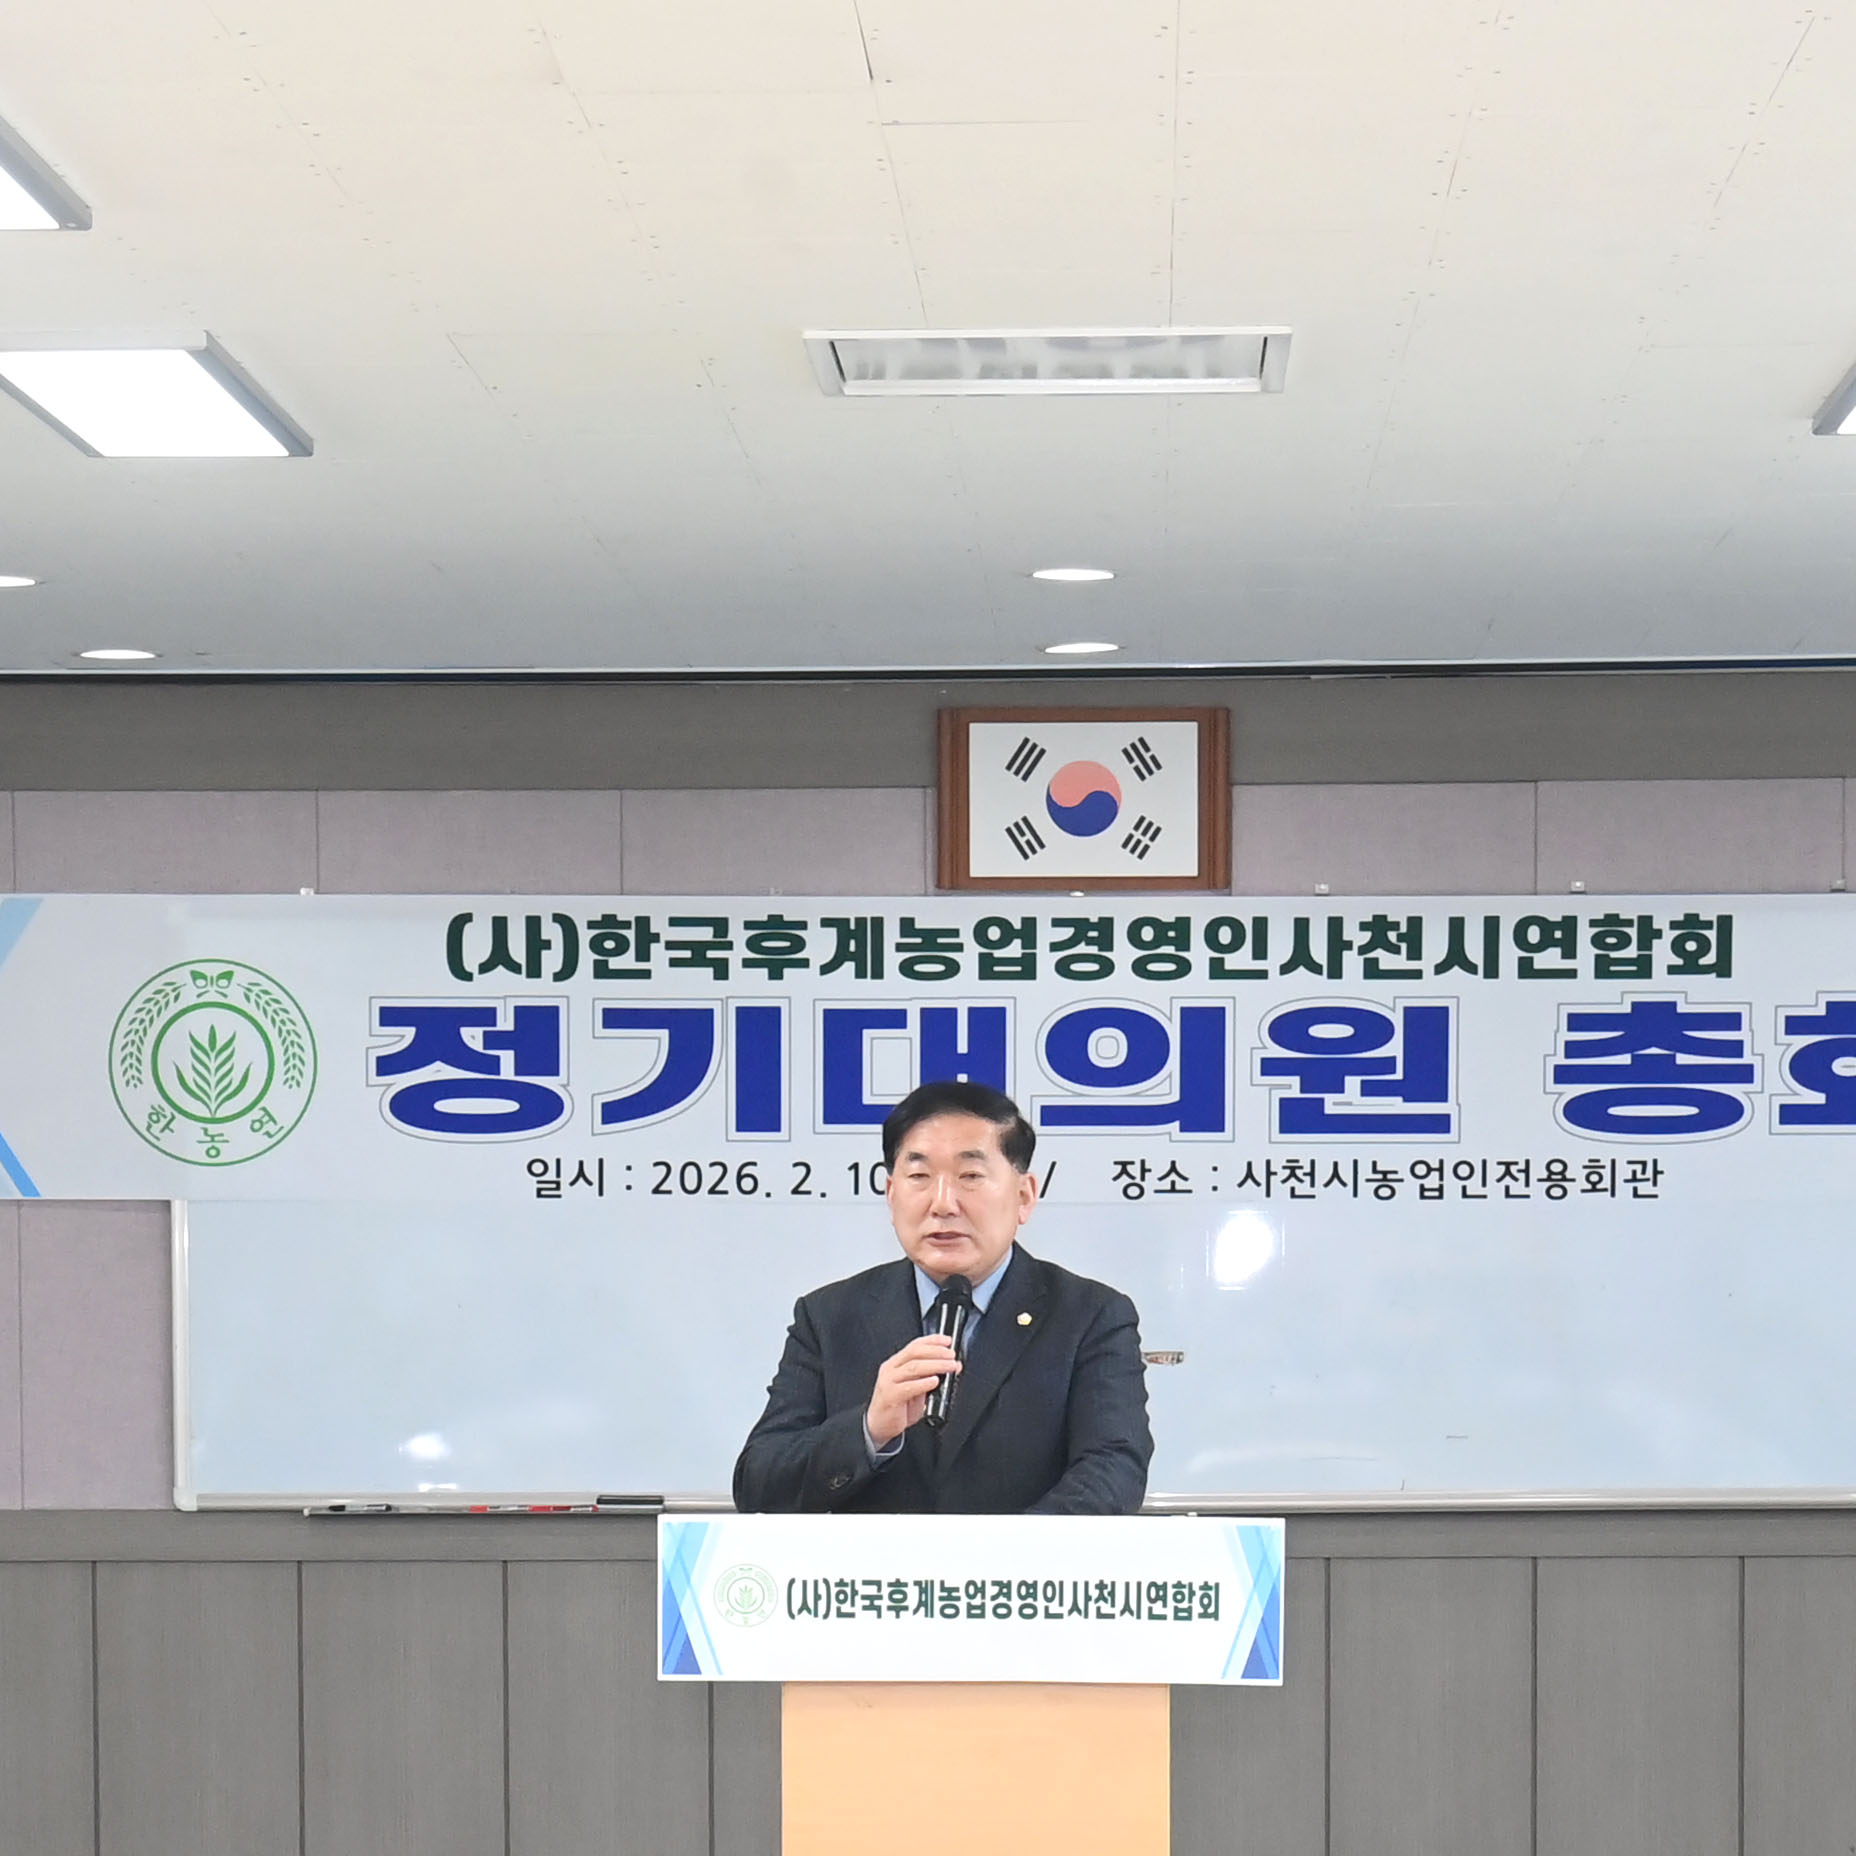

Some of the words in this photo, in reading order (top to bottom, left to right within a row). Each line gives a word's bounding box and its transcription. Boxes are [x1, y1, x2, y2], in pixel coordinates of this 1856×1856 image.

[445, 911, 1734, 984] (사)한국후계농업경영인사천시연합회
[376, 1004, 1453, 1136] 정기대의원
[525, 1156, 605, 1199] 일시
[650, 1160, 772, 1199] 2026.
[789, 1160, 828, 1199] 2.
[1111, 1157, 1194, 1201] 장소
[1236, 1157, 1666, 1202] 사천시농업인전용회관
[785, 1576, 1221, 1623] (사)한국후계농업경영인사천시연합회
